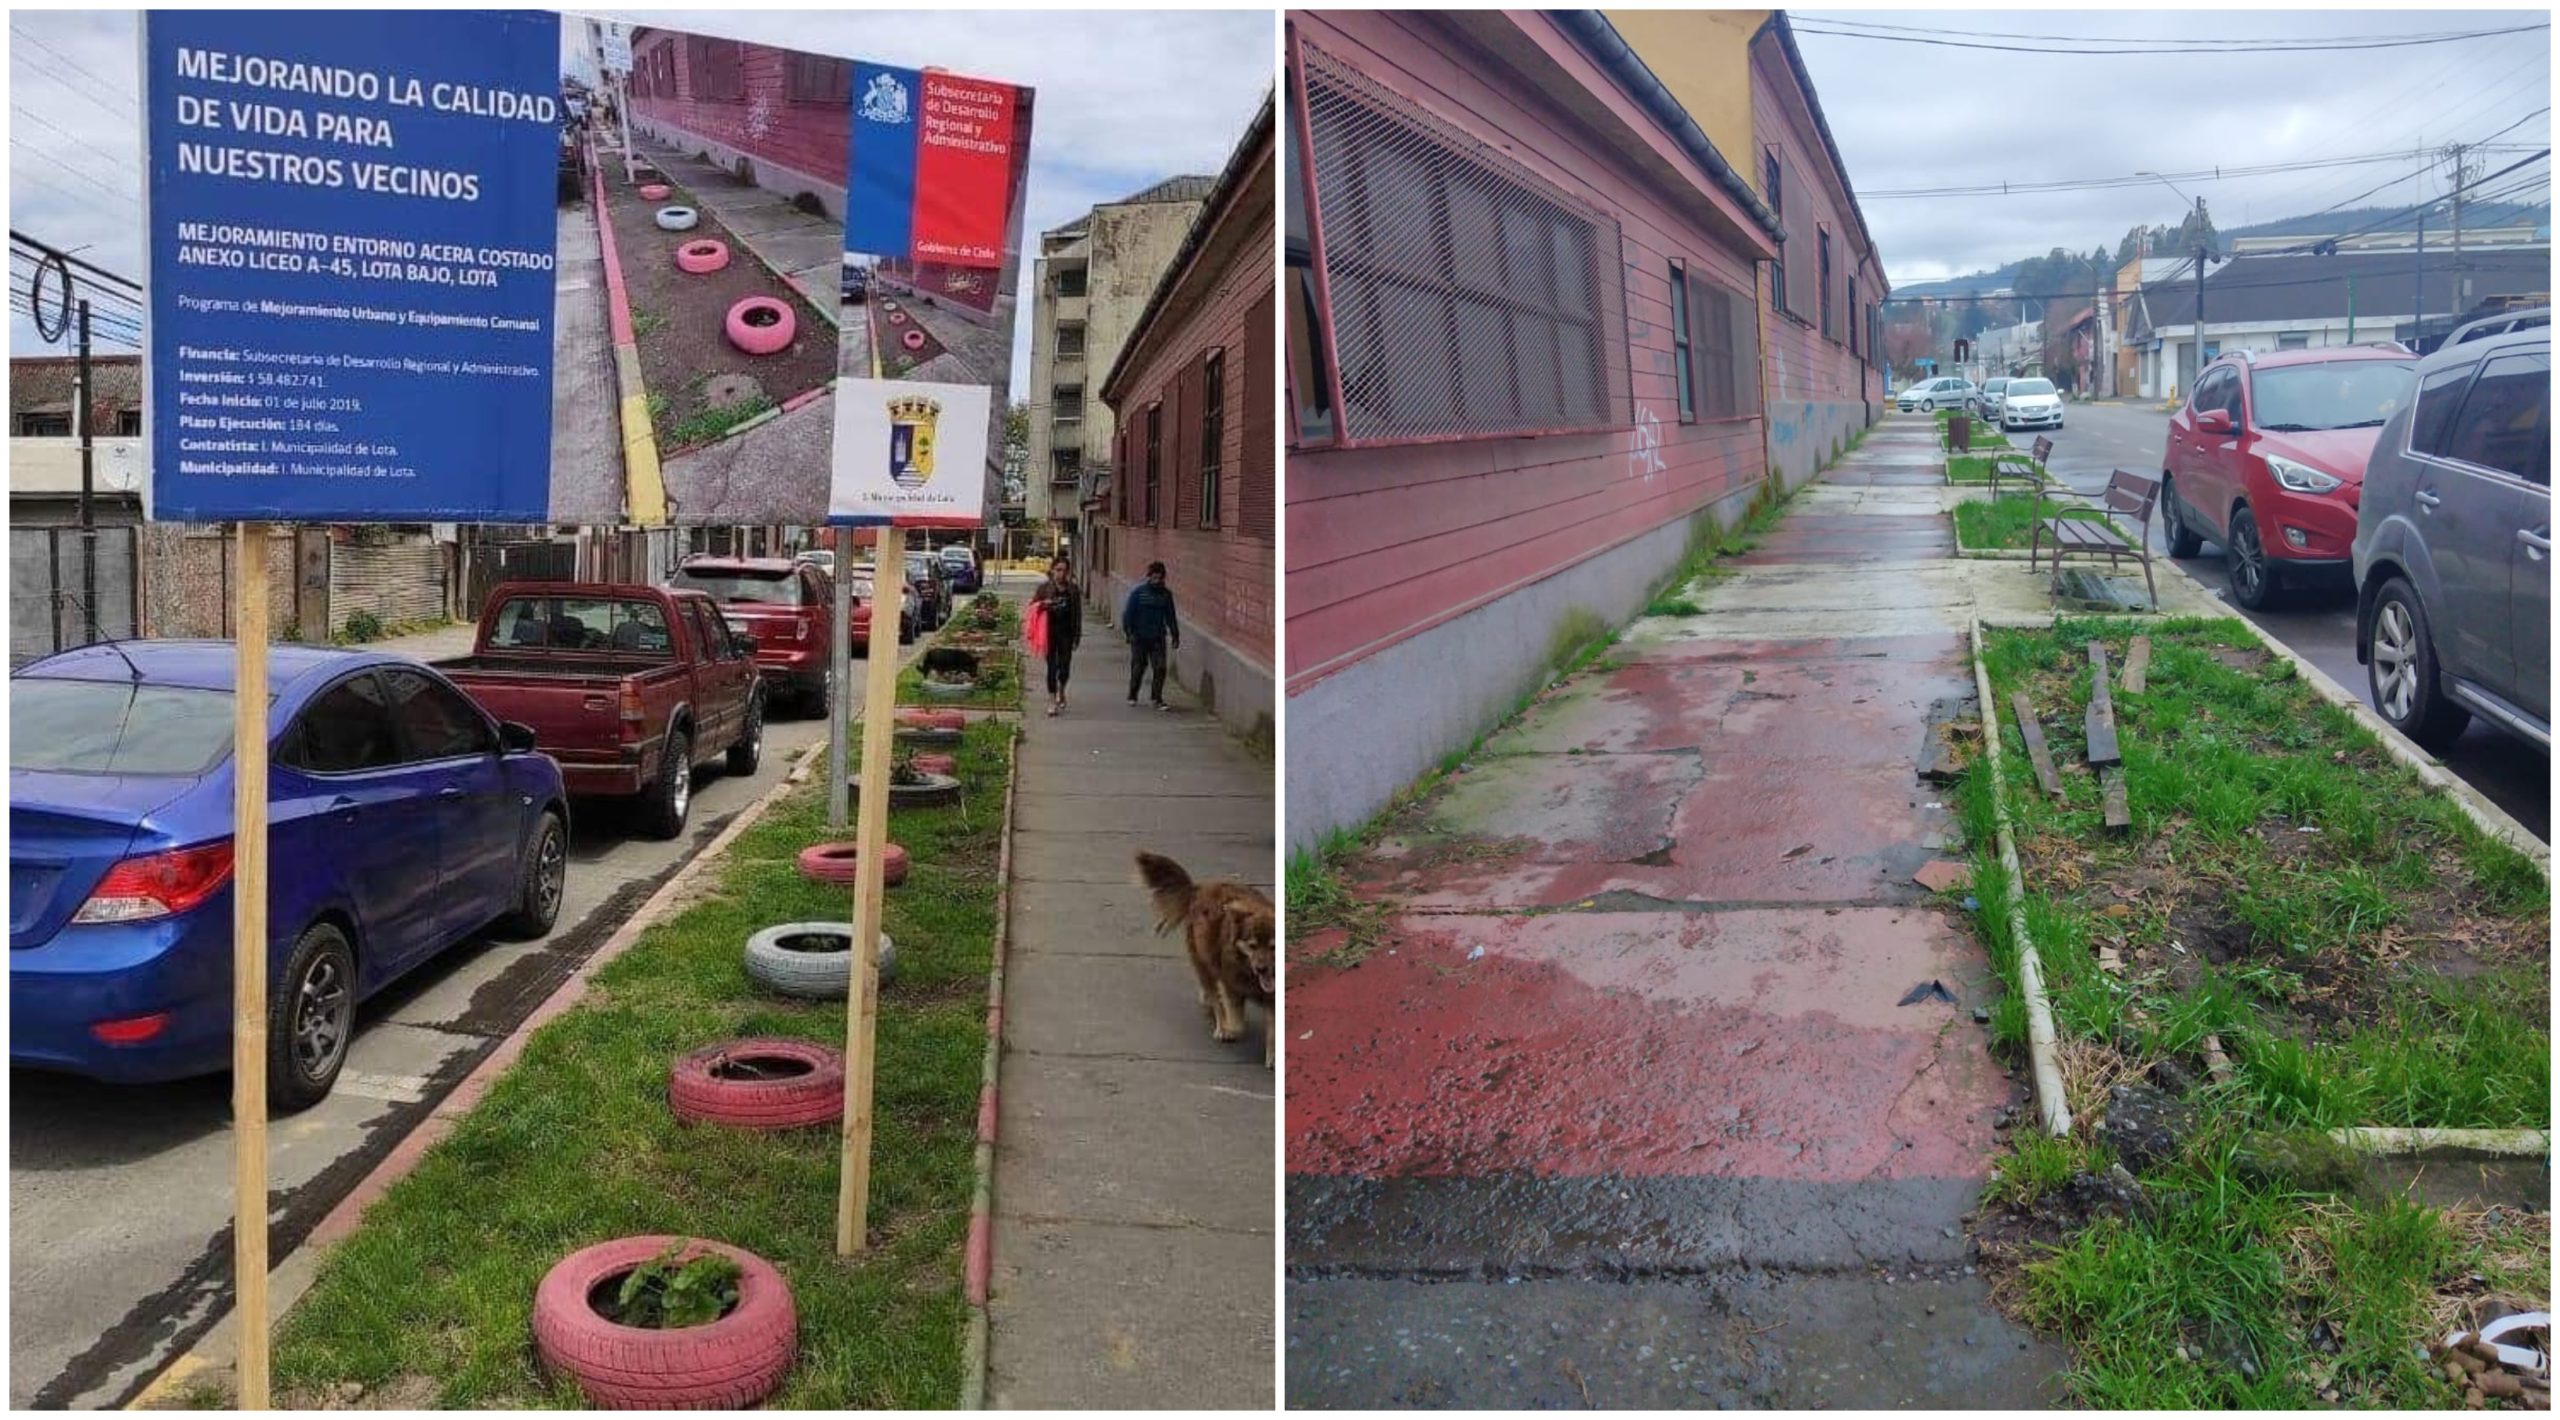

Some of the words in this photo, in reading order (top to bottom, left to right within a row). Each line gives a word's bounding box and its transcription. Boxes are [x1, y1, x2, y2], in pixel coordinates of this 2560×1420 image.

[177, 47, 379, 101] MEJORANDO
[389, 76, 424, 108] LA
[432, 83, 556, 123] CALIDAD
[177, 95, 222, 129] DE
[229, 102, 308, 138] VIDA
[317, 112, 393, 148] PARA
[926, 98, 940, 112] de
[942, 100, 999, 121] Desarrollo
[925, 115, 973, 133] Regional
[974, 125, 983, 139] y
[924, 130, 1006, 154] Administrativo
[178, 142, 343, 187] NUESTROS
[351, 161, 479, 200] VECINOS
[178, 222, 328, 252] MEJORAMIENTO
[333, 236, 415, 259] ENTORNO
[420, 243, 475, 264] ACERA
[478, 249, 554, 270] COSTADO
[917, 240, 957, 255] Gobierno
[960, 245, 971, 256] de
[973, 246, 996, 259] Chile
[178, 245, 244, 267] ANEXO
[250, 252, 302, 271] LICEO
[362, 260, 402, 279] LOTA
[407, 264, 455, 286] BAJO,
[459, 269, 498, 287] LOTA
[178, 294, 240, 313] Programa
[242, 300, 259, 312] de
[260, 299, 350, 319] Mejoramiento
[352, 307, 396, 322] Urbano
[399, 313, 407, 325] y
[408, 310, 488, 328] Equipamiento
[490, 316, 540, 331] Comunal
[179, 346, 240, 361] Financia:
[326, 354, 341, 366] de
[343, 354, 401, 369] Desarrollo
[403, 358, 450, 374] Regional
[452, 363, 459, 375] y
[248, 373, 254, 385] $
[179, 392, 219, 406] Fecha
[222, 393, 263, 408] Inicio:
[265, 397, 280, 408] 01
[283, 397, 299, 409] de
[301, 398, 326, 411] julio
[179, 415, 216, 429] Plazo
[219, 416, 286, 432] Ejecución:
[289, 419, 311, 432] 184
[180, 438, 259, 452] Contratista:
[271, 441, 352, 456] Municipalidad
[355, 443, 369, 455] de
[180, 461, 280, 477] Municipalidad:
[291, 464, 371, 478] Municipalidad
[373, 465, 388, 477] de
